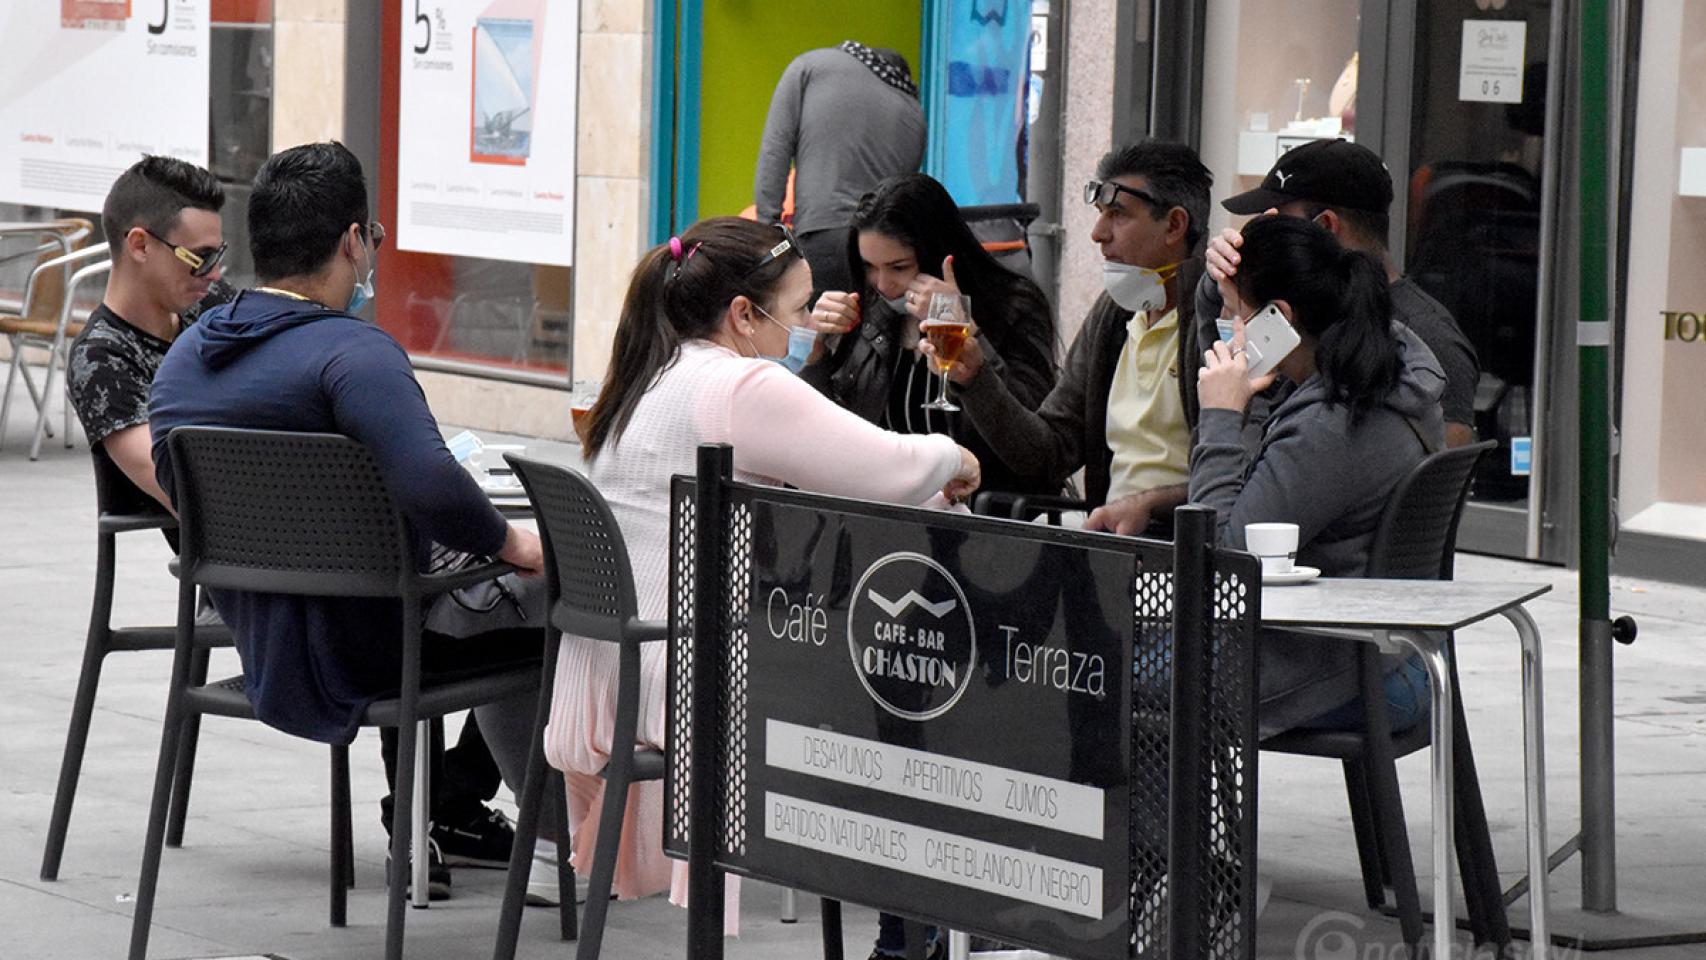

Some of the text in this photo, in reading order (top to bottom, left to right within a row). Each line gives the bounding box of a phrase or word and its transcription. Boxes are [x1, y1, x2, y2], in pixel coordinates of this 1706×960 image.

[1659, 311, 1706, 343] TO
[767, 586, 828, 646] Café
[917, 628, 945, 651] BAR
[863, 646, 957, 689] CHASTON
[998, 624, 1106, 696] Terraza
[804, 736, 1058, 819] DESAYUNOS APERITIVOS ZUMOS
[774, 802, 1091, 906] BATIDOS NATURALES CAFE BLANCO Y NEGRO
